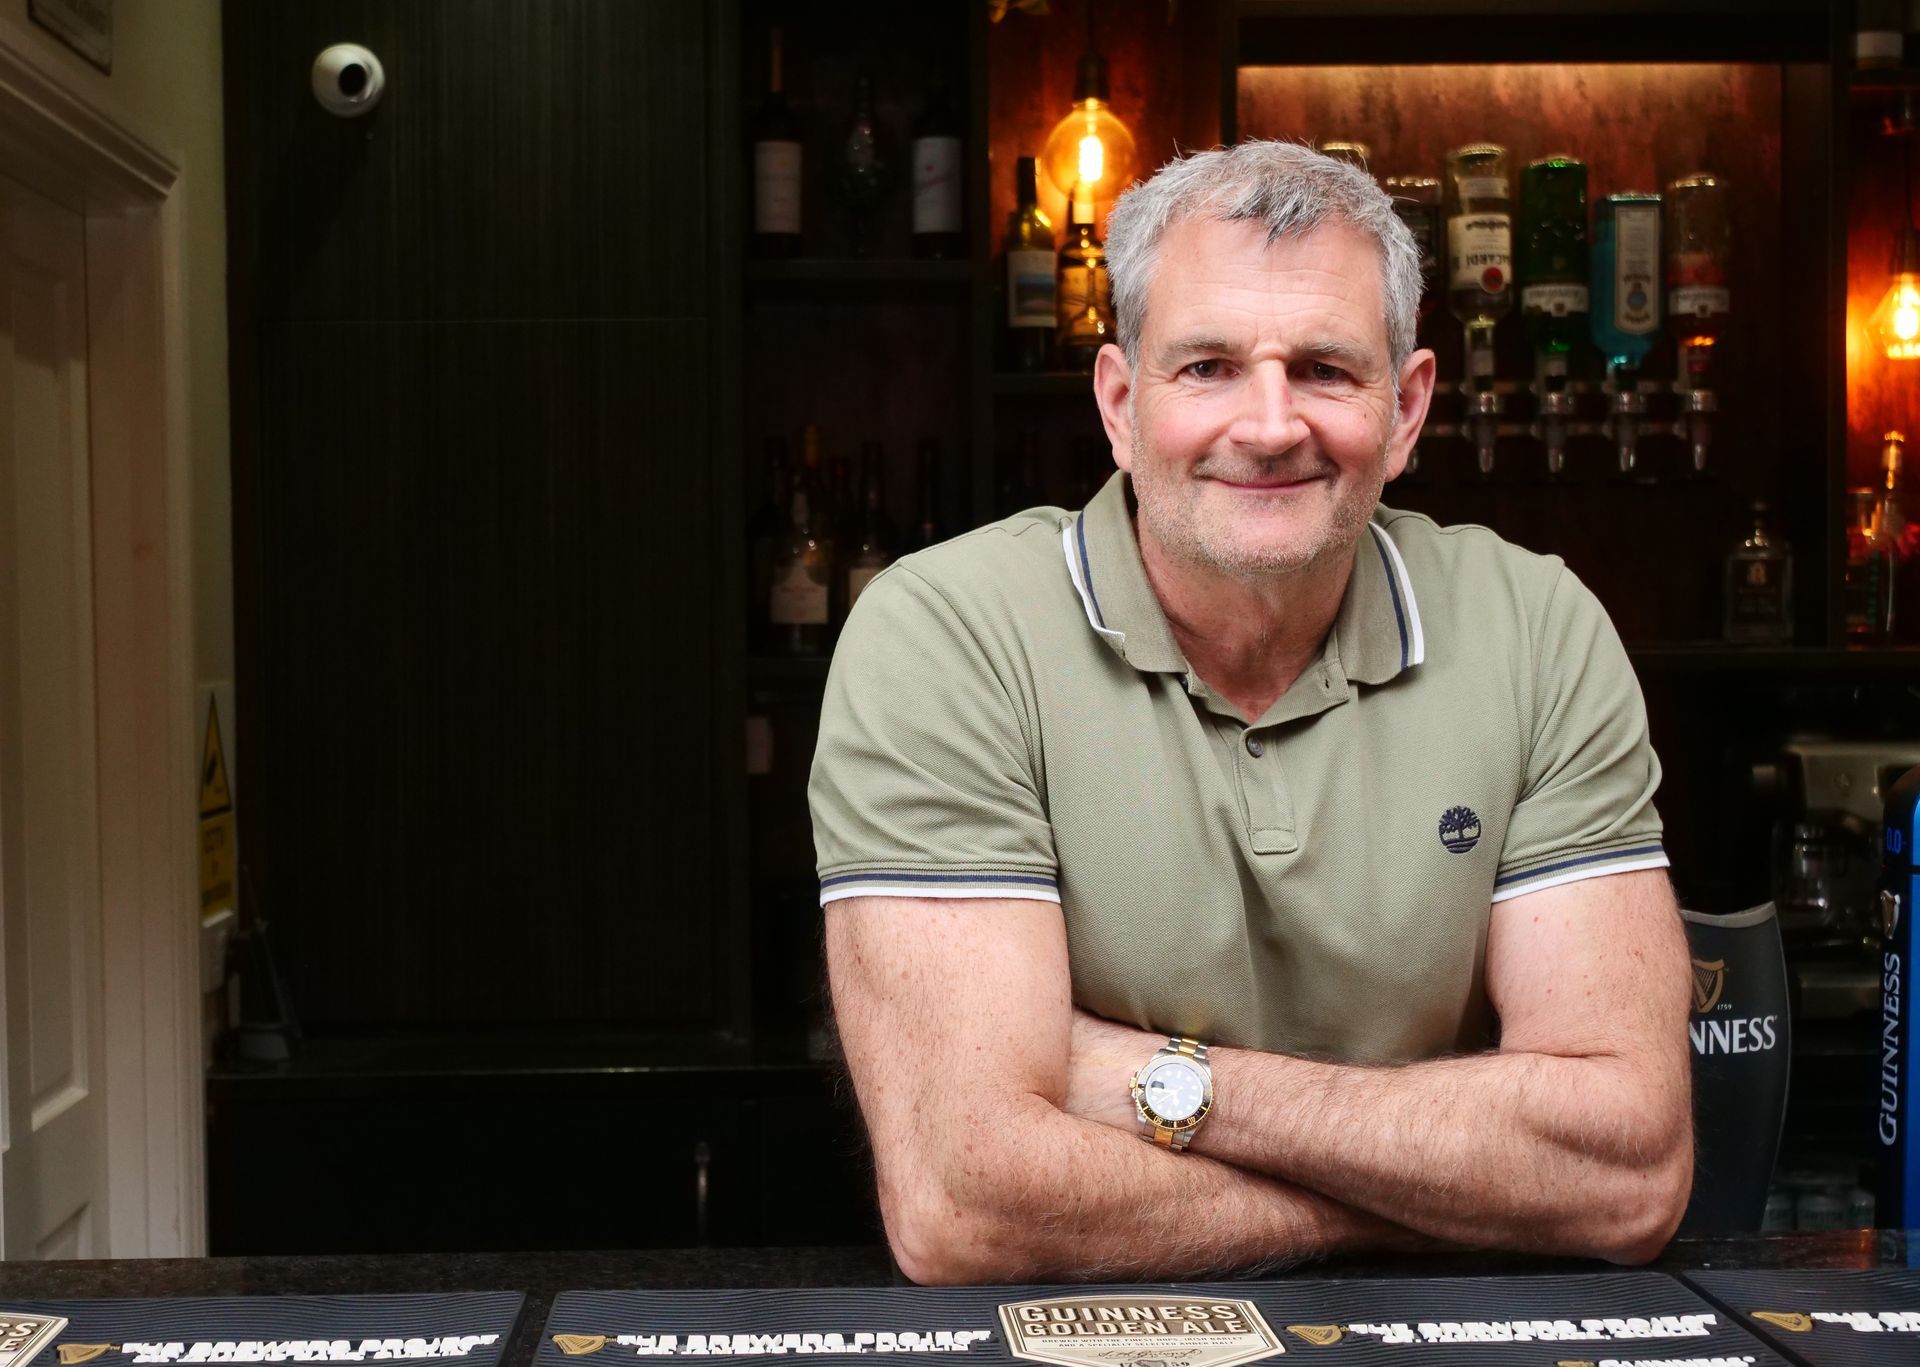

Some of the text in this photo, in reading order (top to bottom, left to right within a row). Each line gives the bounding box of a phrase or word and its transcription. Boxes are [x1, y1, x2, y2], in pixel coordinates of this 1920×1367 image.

[1688, 1015, 1777, 1055] NNESS
[1879, 952, 1900, 1146] GUINNESS
[1019, 1306, 1238, 1321] GUINNESS
[1024, 1320, 1250, 1335] GOLDEN ALE
